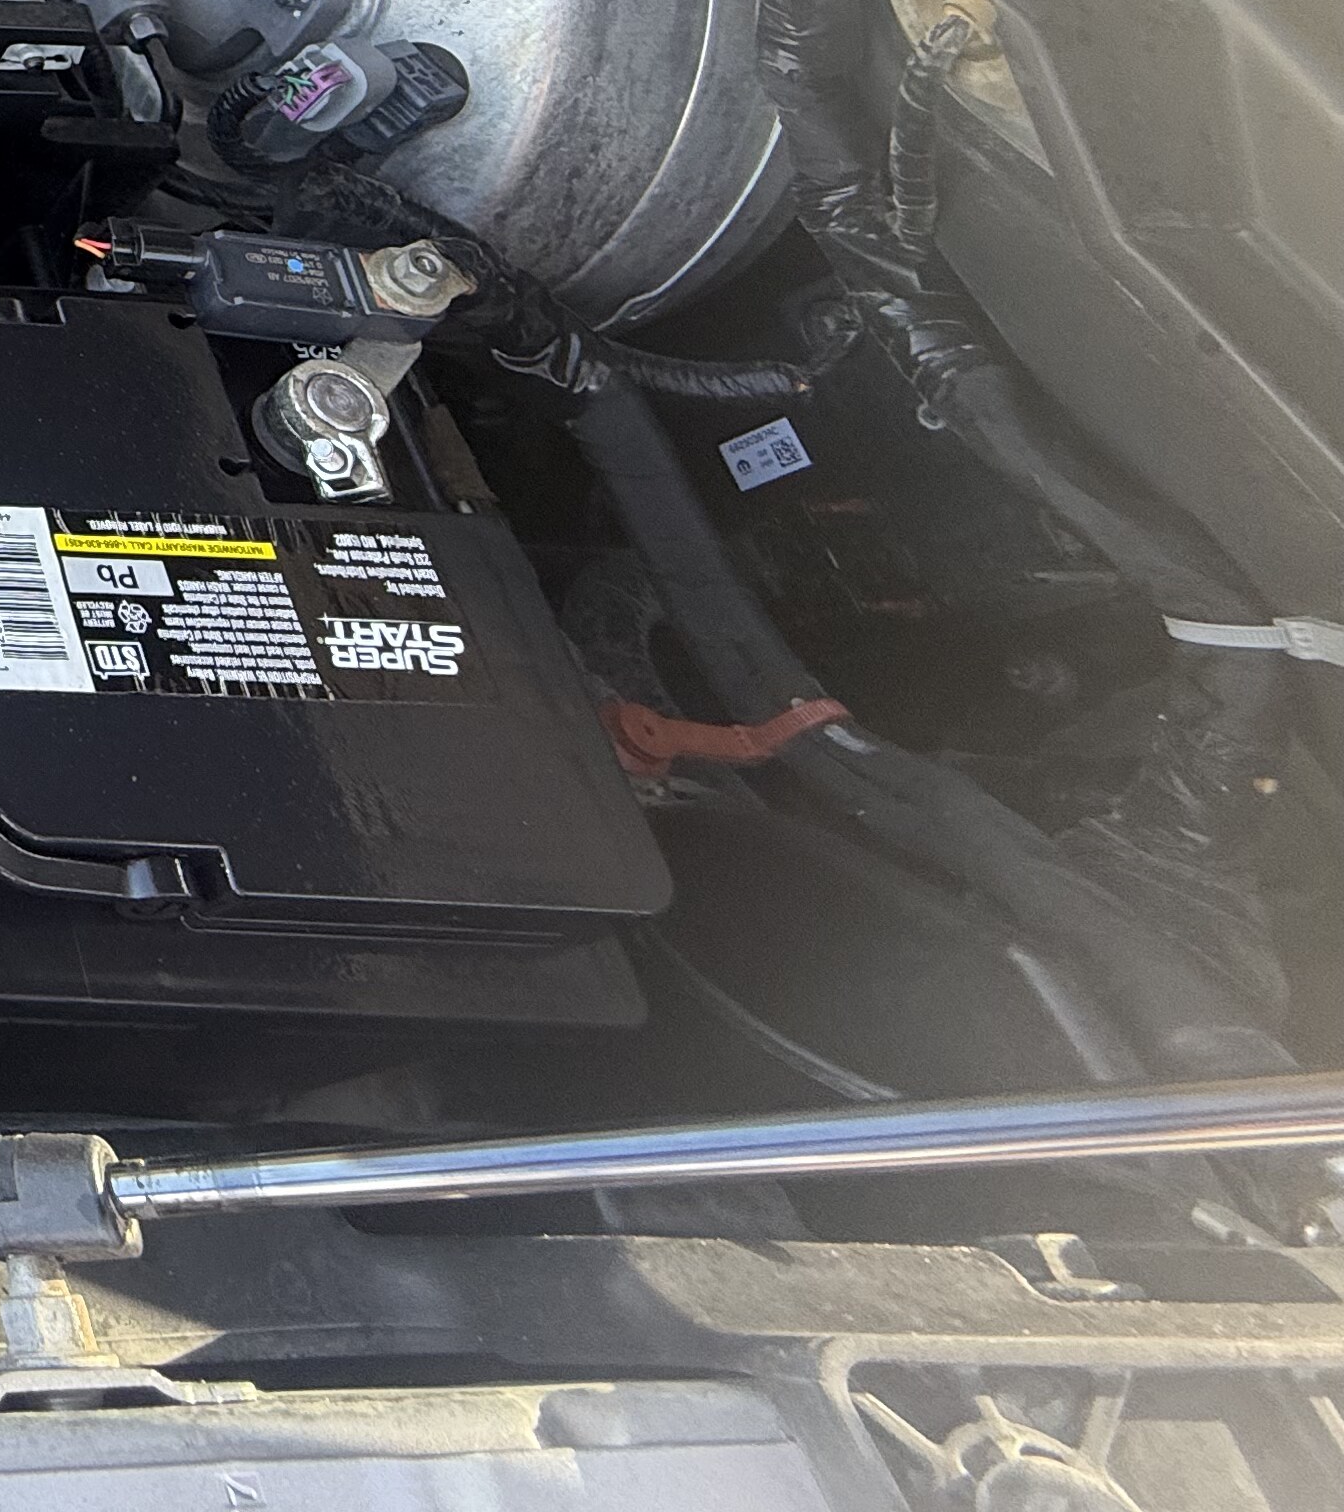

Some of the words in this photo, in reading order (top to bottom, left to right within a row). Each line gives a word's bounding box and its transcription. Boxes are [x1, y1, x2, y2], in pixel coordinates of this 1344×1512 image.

[129, 540, 153, 550] CALL
[155, 542, 204, 554] WARRANTY
[206, 545, 264, 555] NATIONWIDE
[96, 564, 139, 589] Pb
[324, 621, 464, 654] START
[93, 645, 140, 671] STD
[330, 646, 458, 675] SUPER
